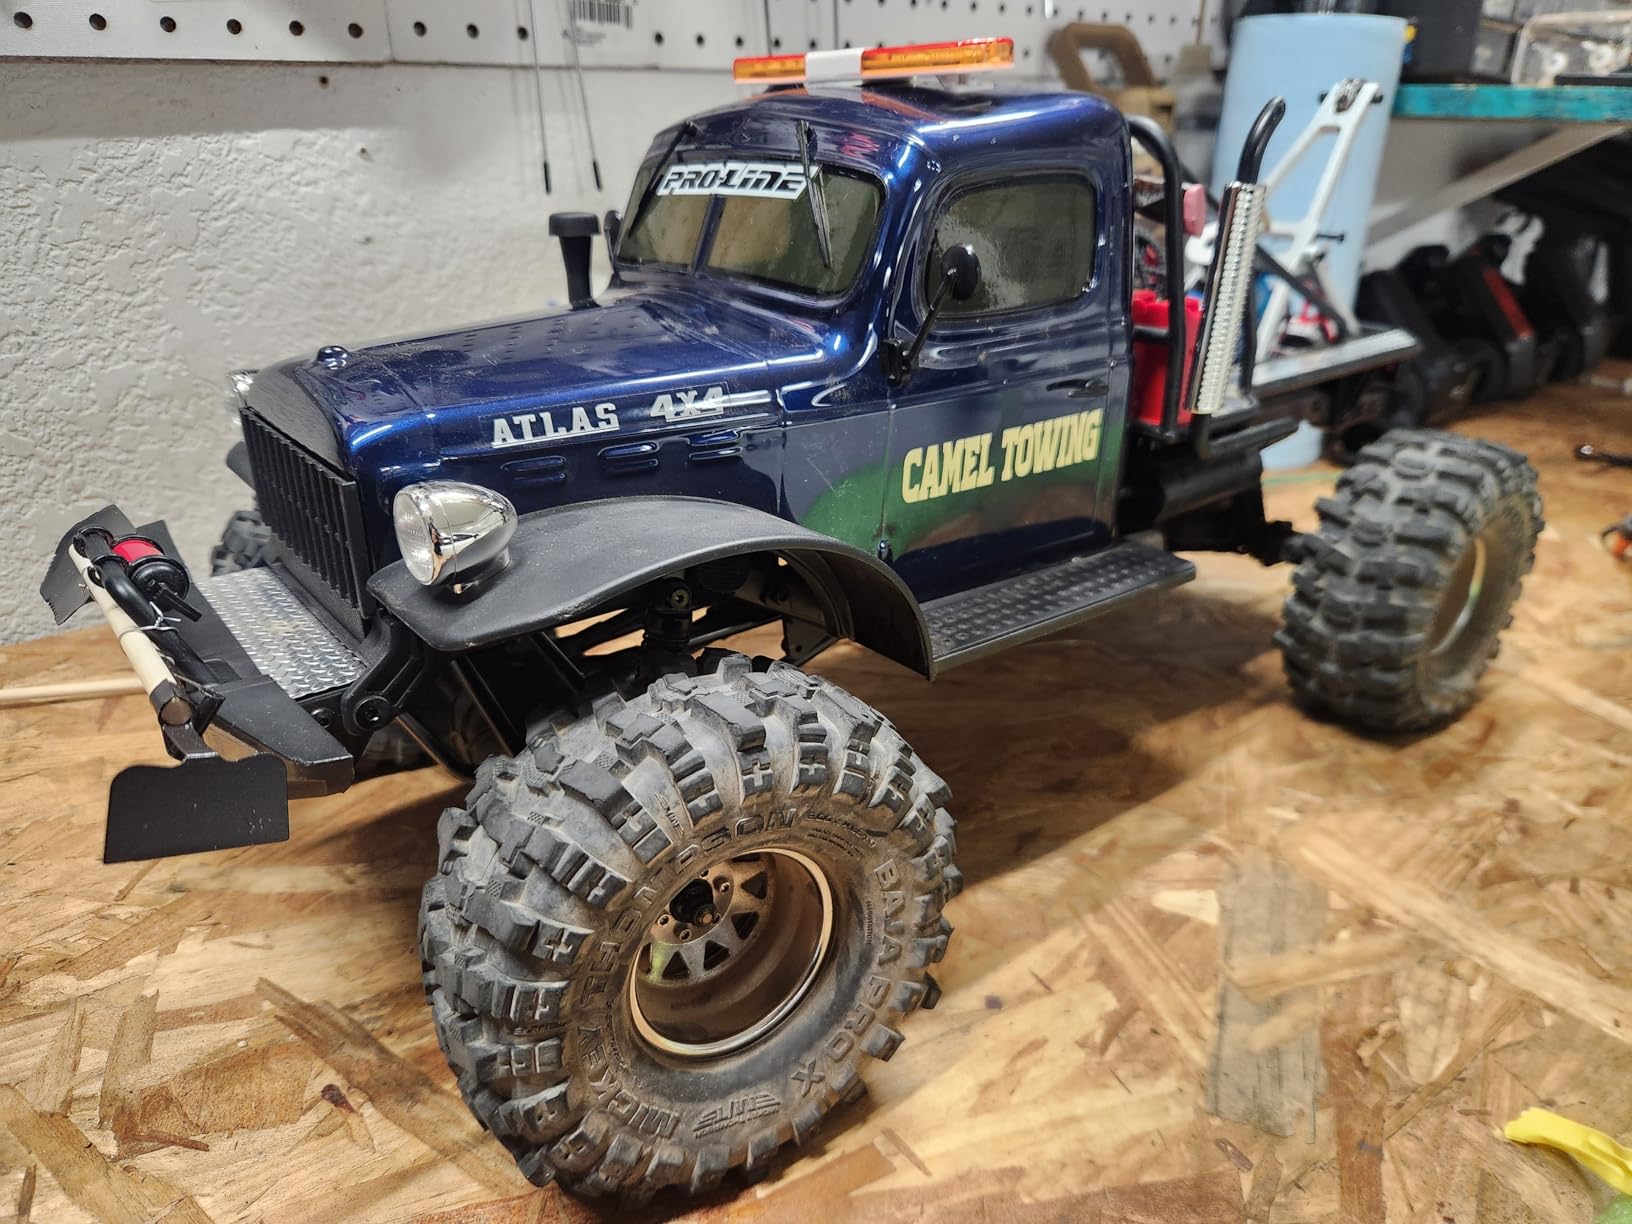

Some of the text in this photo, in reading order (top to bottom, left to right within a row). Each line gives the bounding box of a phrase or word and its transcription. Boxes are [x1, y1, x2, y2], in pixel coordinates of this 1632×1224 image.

[491, 402, 620, 448] ATLAS
[902, 407, 1104, 504] CAMEL TOWING
[578, 806, 798, 1139] MICKEY THOMPSON
[790, 858, 905, 1098] BAJA PRO X
